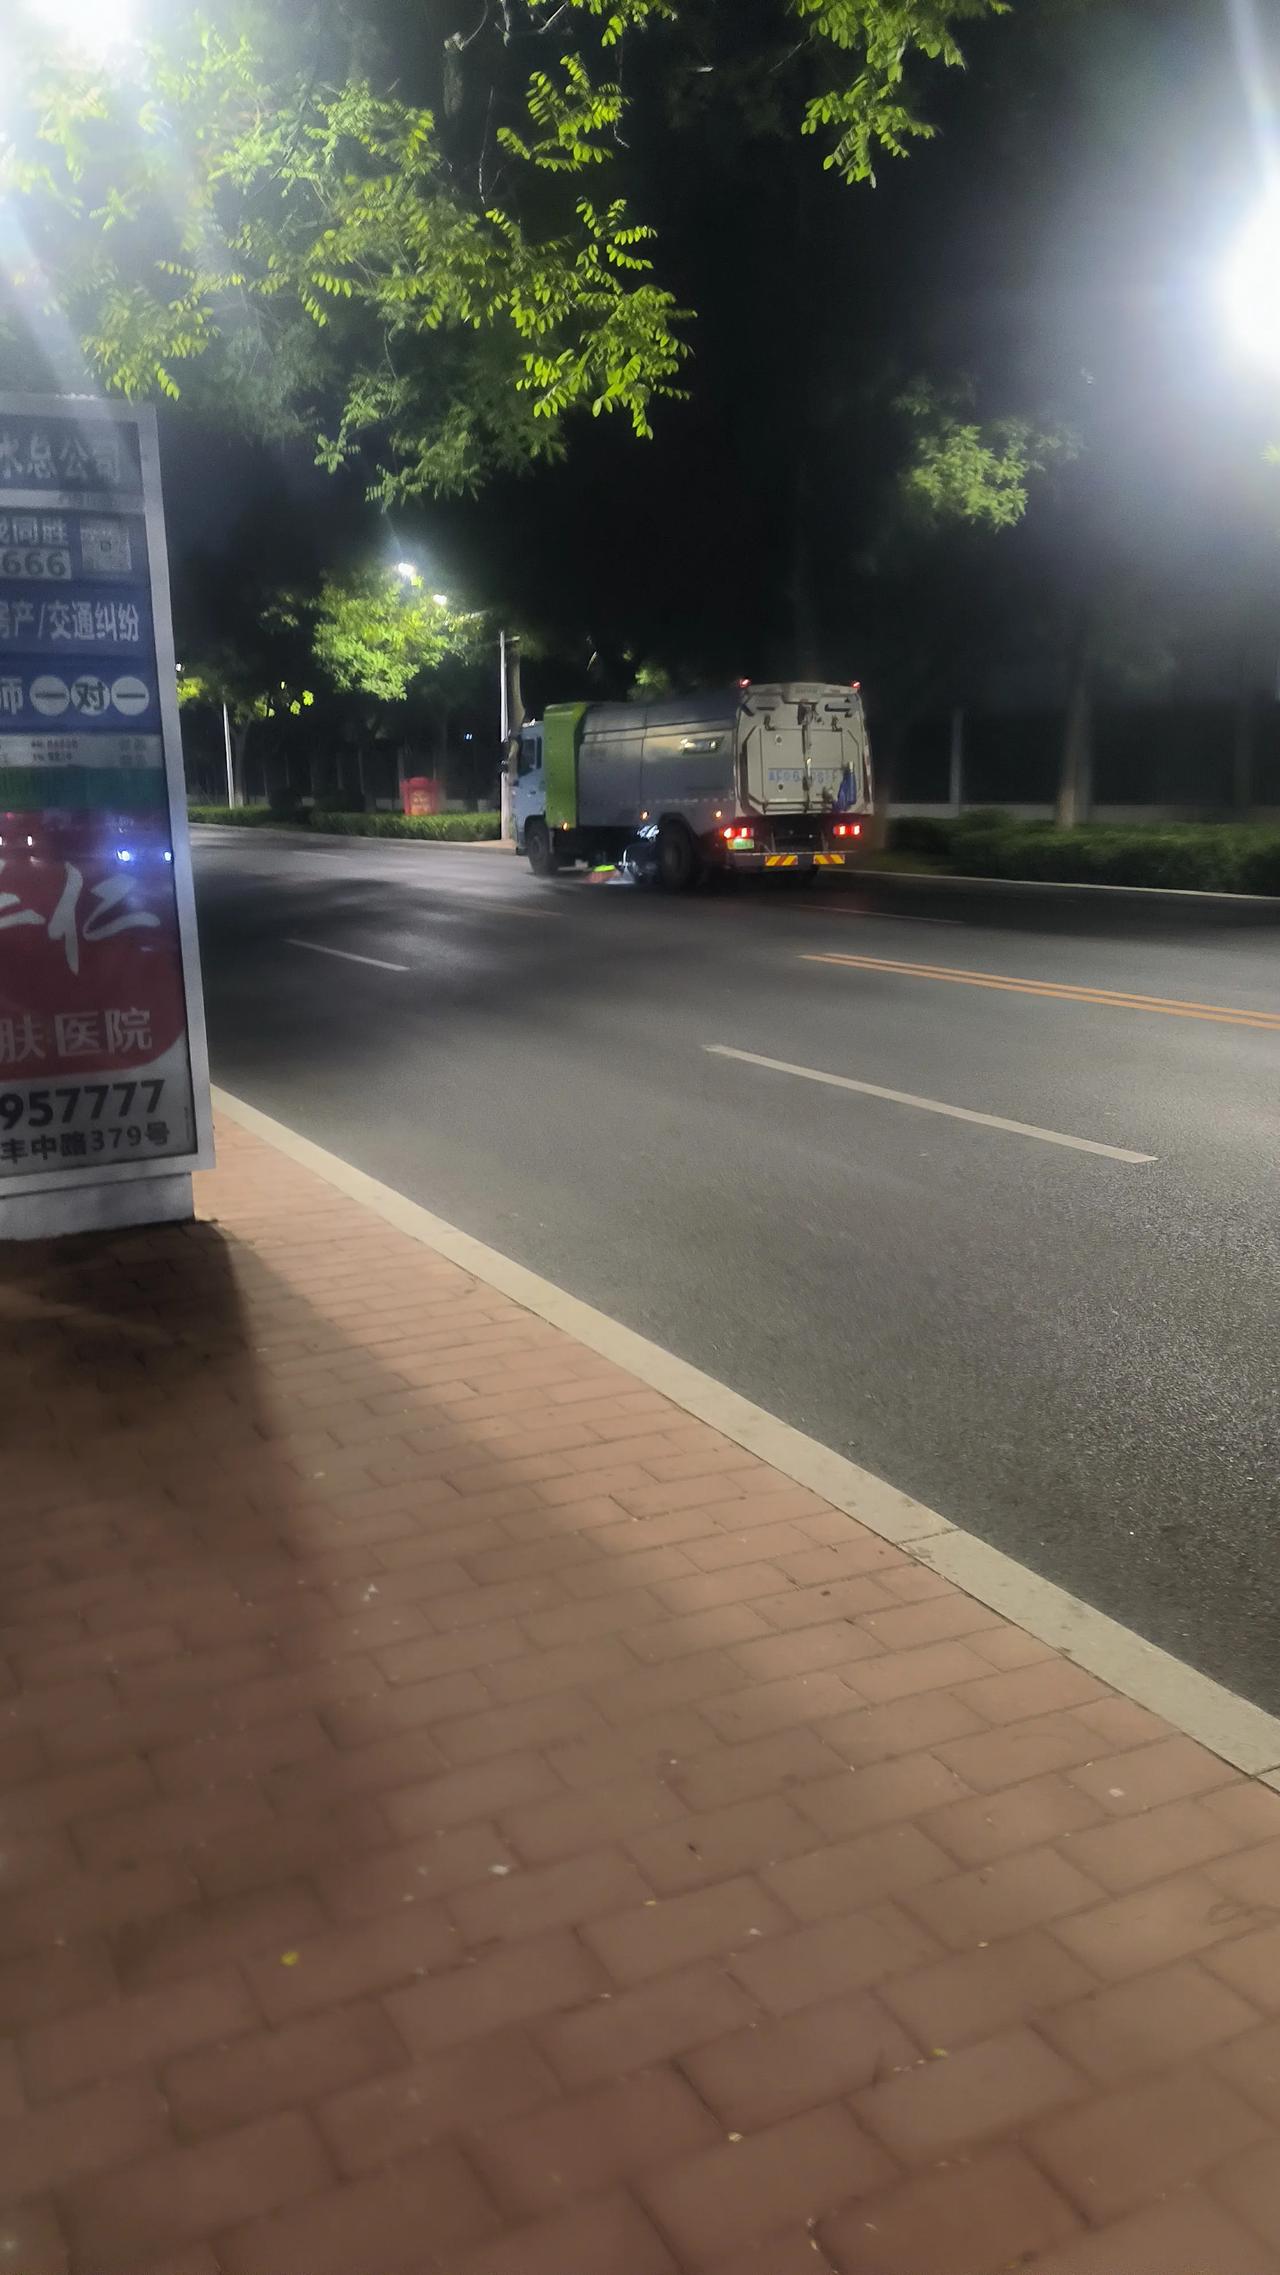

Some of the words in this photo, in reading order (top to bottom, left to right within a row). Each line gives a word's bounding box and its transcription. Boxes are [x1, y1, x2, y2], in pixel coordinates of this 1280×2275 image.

[2, 551, 65, 577] 666
[0, 1006, 153, 1064] 肤医院
[0, 1078, 166, 1131] 957777
